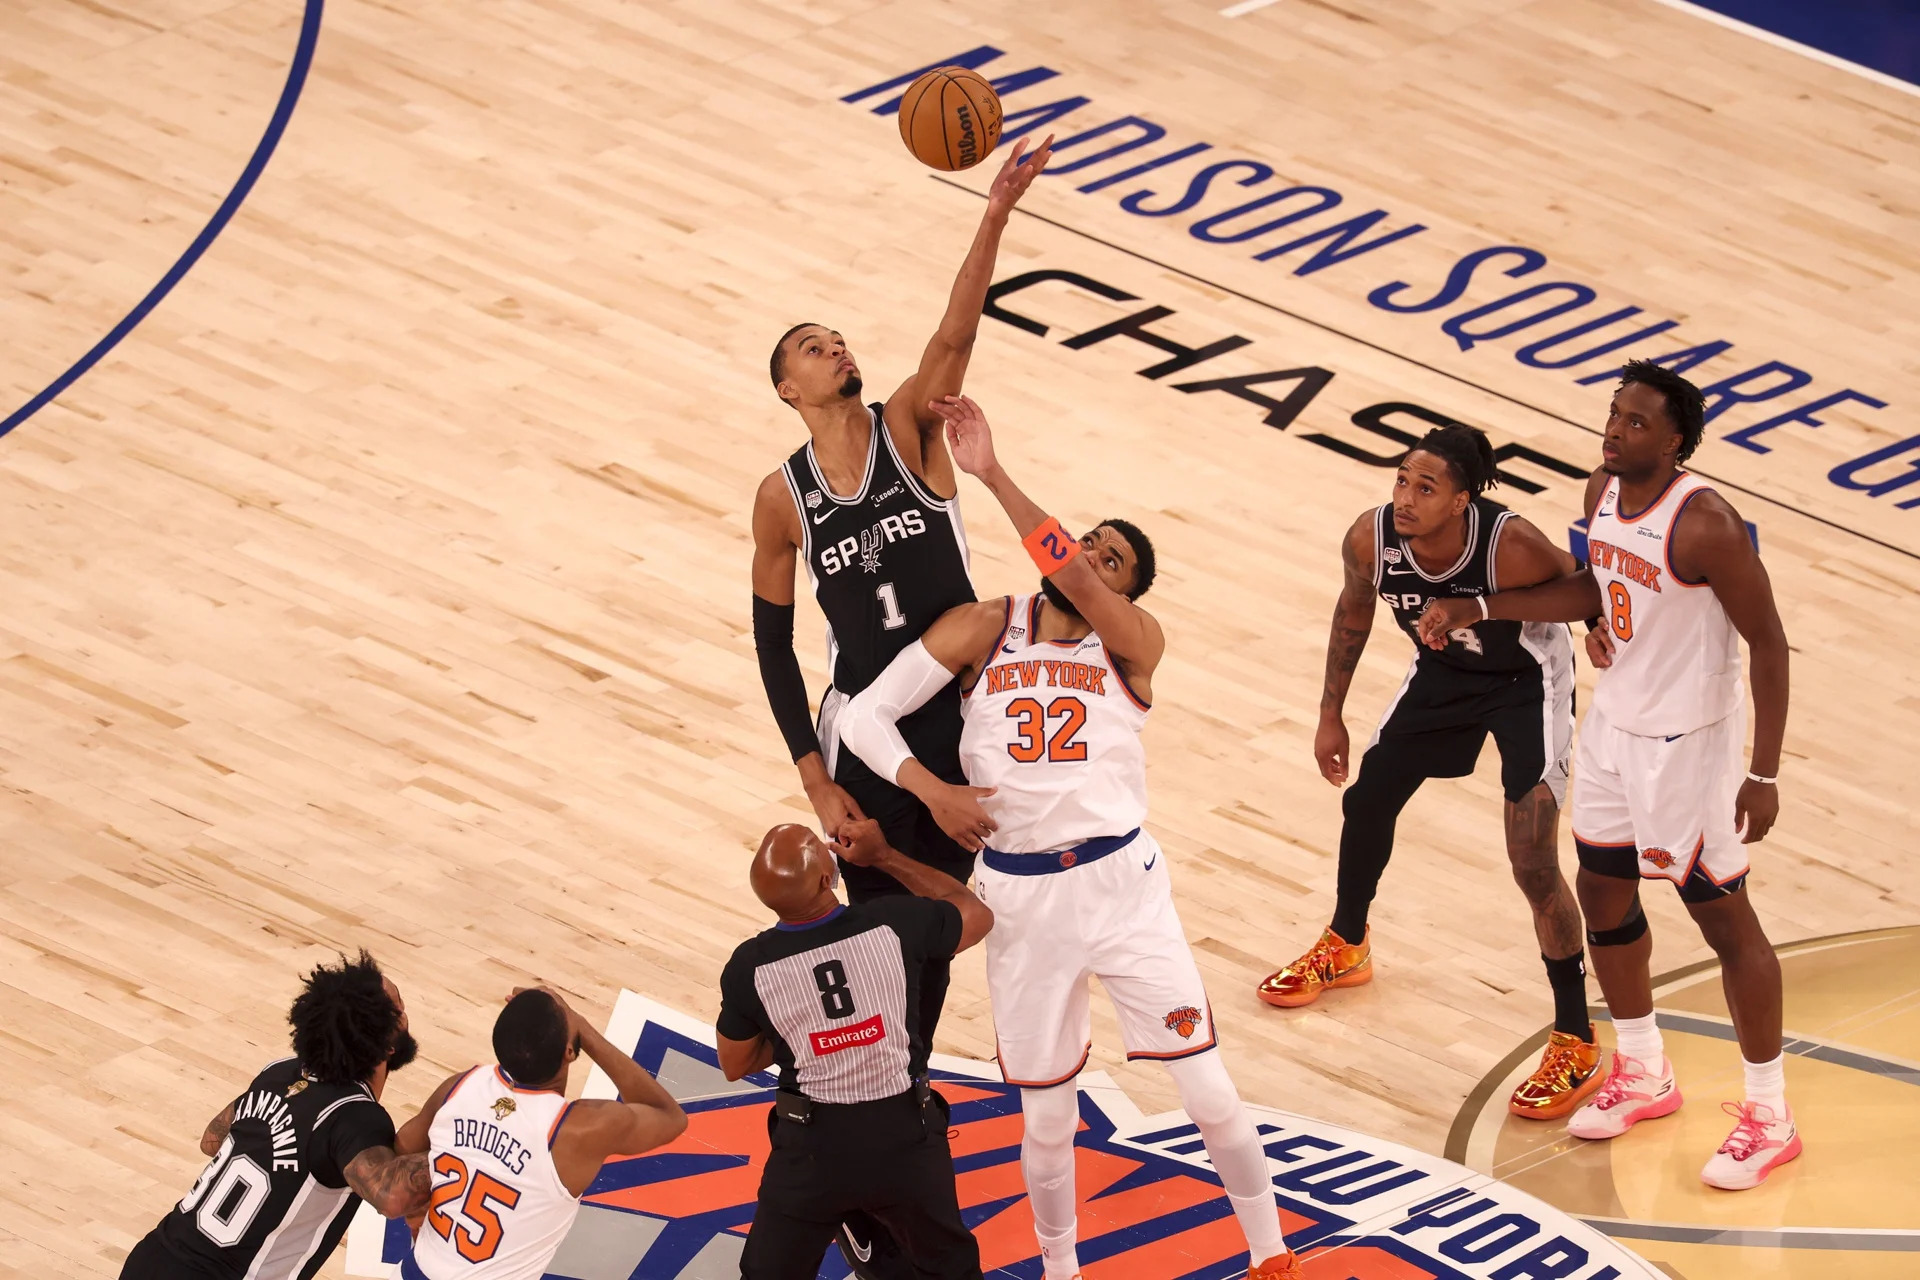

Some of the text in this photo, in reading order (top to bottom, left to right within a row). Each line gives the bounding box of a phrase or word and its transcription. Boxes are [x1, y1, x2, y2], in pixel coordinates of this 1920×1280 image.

[957, 103, 977, 168] Wilson
[875, 486, 900, 503] LEDGER
[820, 509, 926, 575] SPURS
[1614, 547, 1661, 593] YORK
[876, 582, 907, 631] 1
[1454, 586, 1481, 594] LEDGER
[1608, 580, 1633, 643] 8
[986, 660, 1108, 697] NEW YORK
[1005, 696, 1088, 763] 32
[813, 959, 856, 1020] 8
[1165, 1006, 1202, 1030] KNICKS
[818, 1024, 879, 1050] Emirates
[231, 1090, 299, 1172] HAMPAGNIE
[454, 1119, 532, 1175] BRIDGES
[179, 1132, 272, 1248] 30
[428, 1152, 522, 1265] 25
